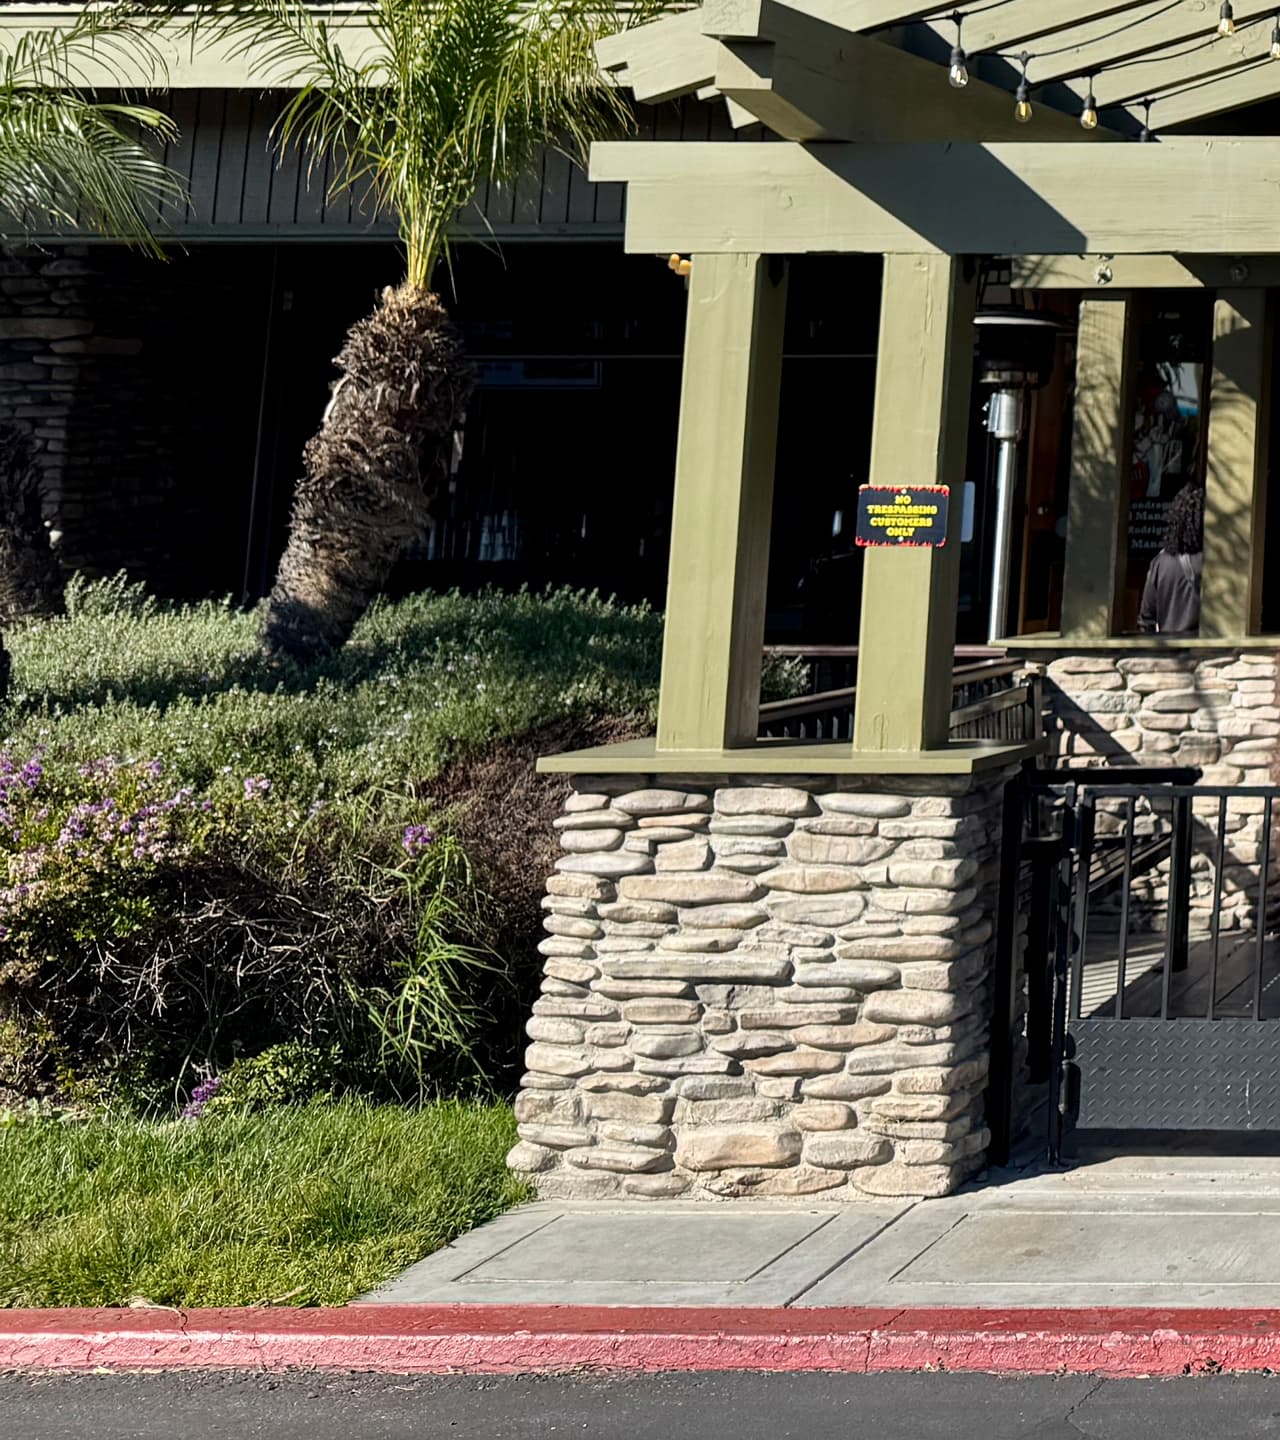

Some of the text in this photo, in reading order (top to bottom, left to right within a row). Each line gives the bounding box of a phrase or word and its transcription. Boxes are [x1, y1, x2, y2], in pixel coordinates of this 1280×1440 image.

[894, 495, 912, 505] NO
[866, 505, 938, 514] TRESPASSING
[870, 517, 933, 527] CUSTOMERS
[886, 527, 915, 536] ONLY
